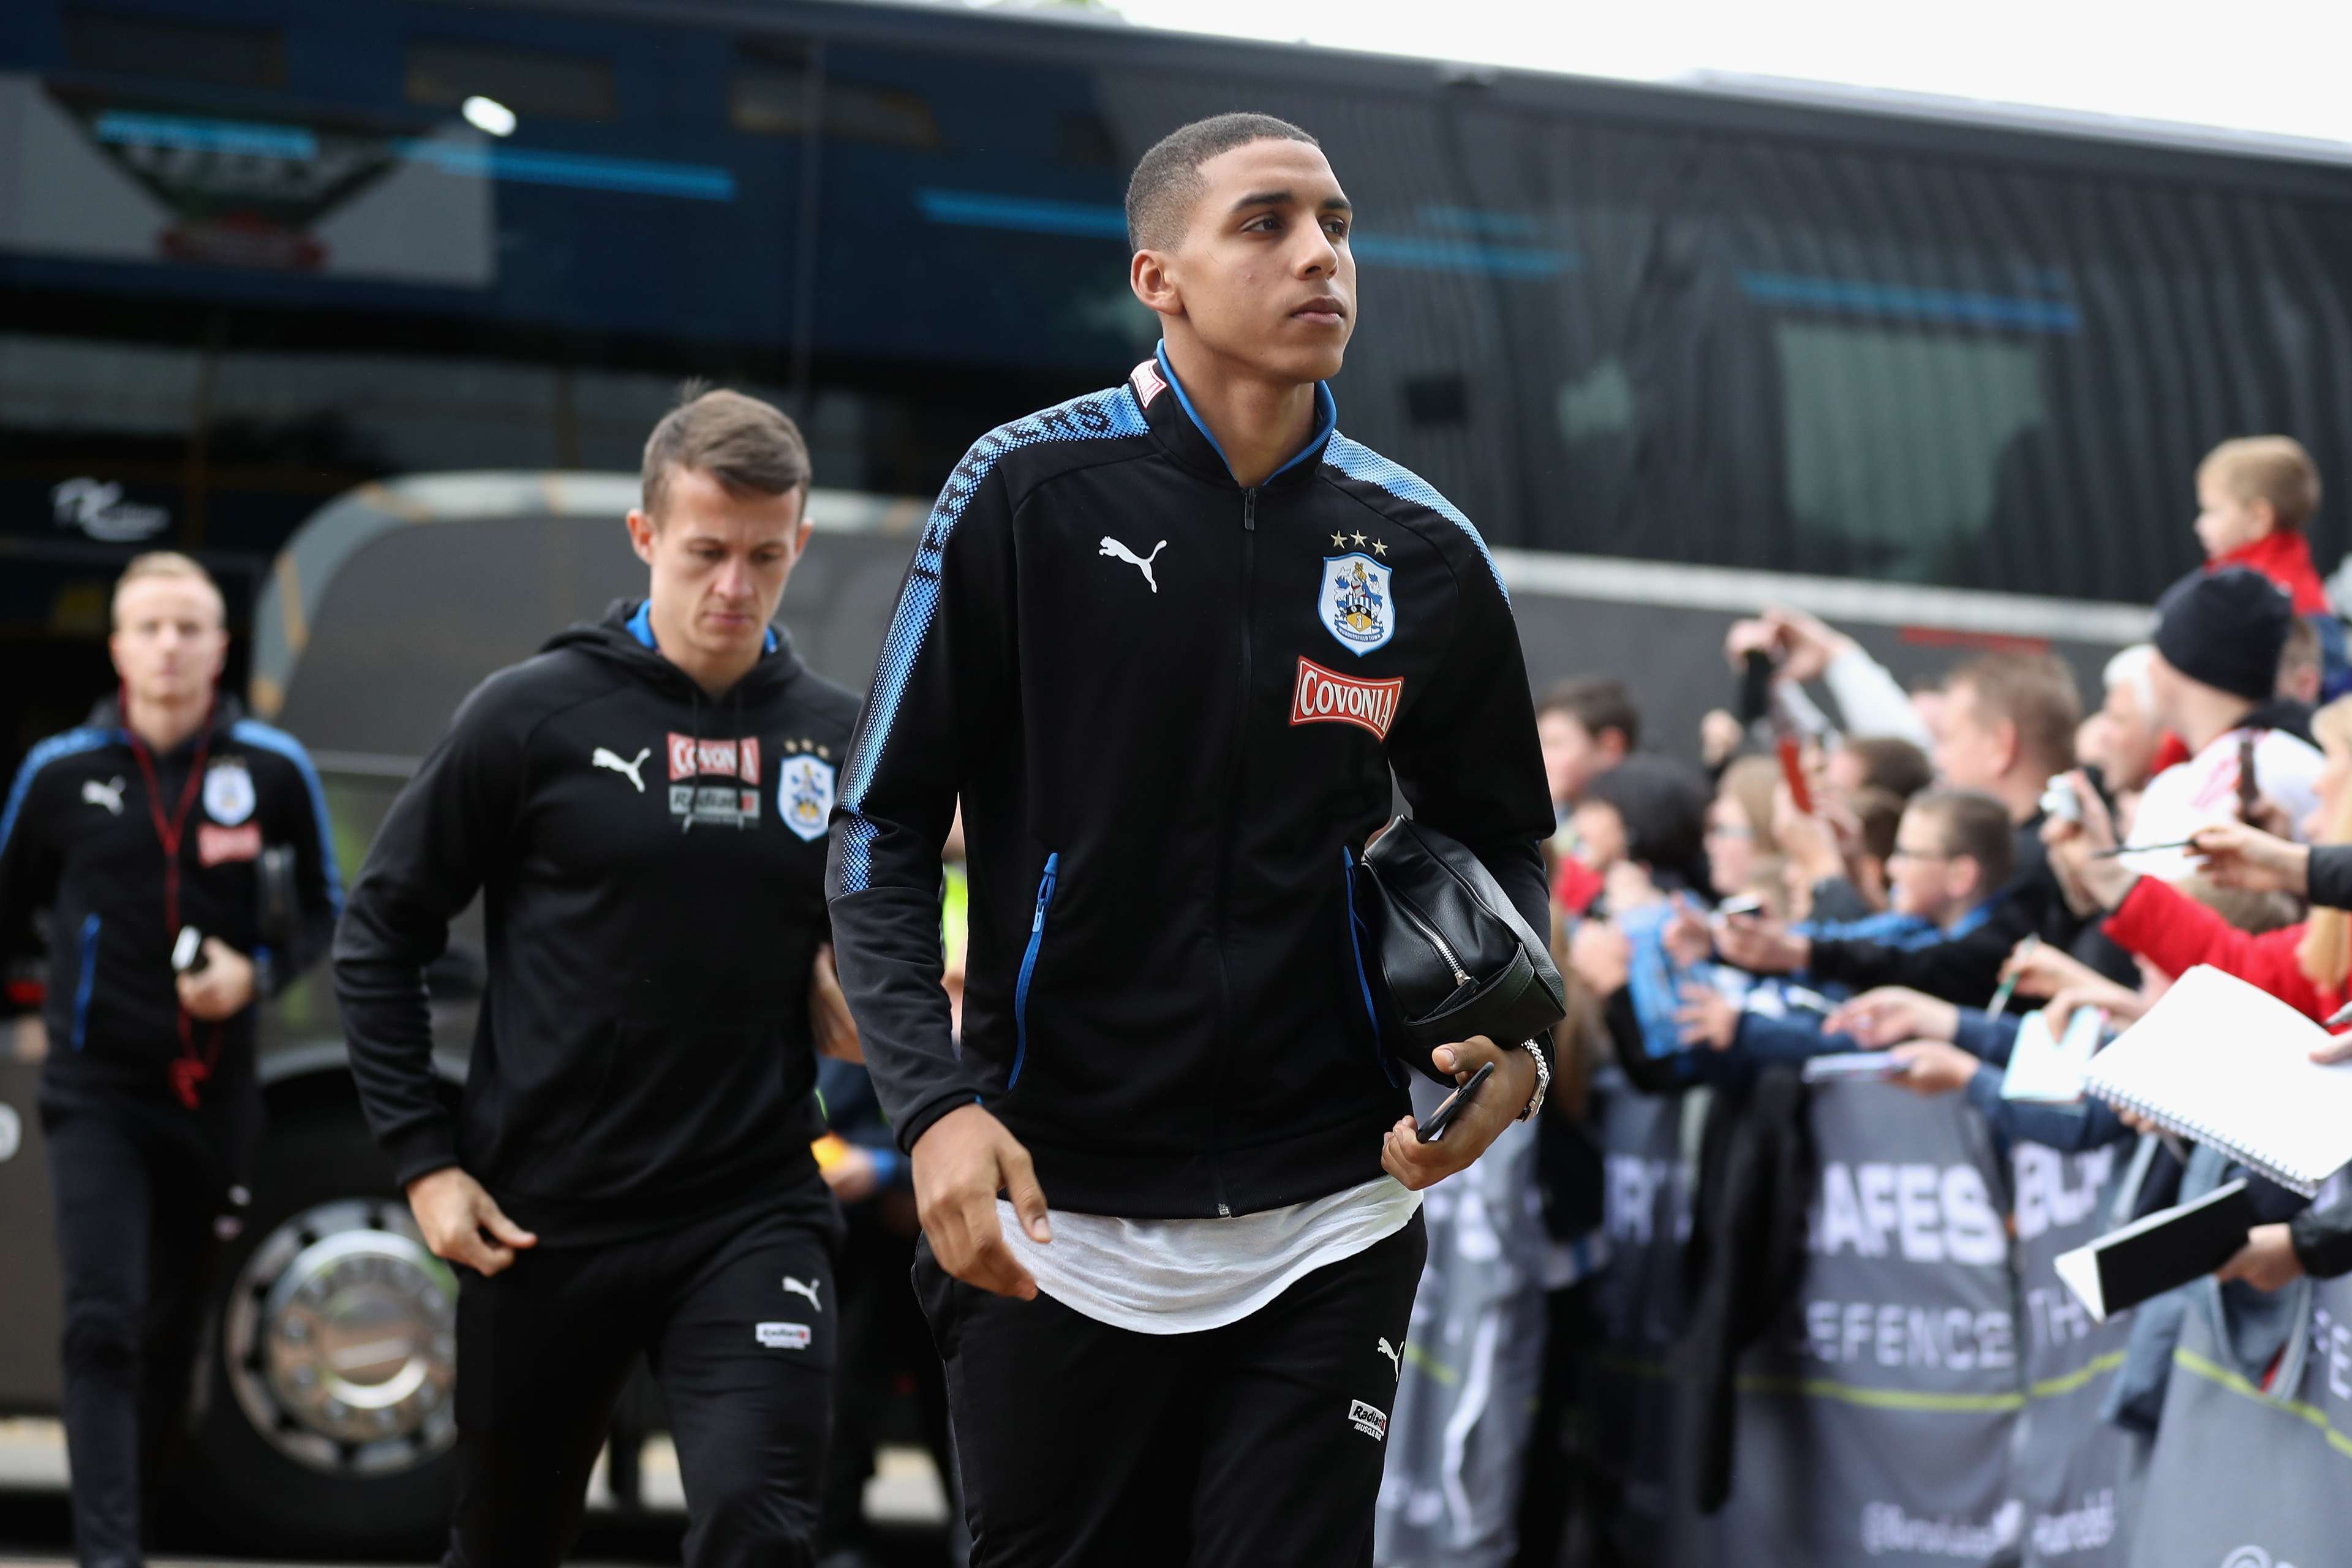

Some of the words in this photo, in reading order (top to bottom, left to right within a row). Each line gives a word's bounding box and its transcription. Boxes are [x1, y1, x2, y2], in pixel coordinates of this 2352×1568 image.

[1300, 669, 1392, 734] COVONIA
[673, 739, 756, 777] COVONA
[1809, 1161, 2008, 1265] AFES
[1806, 1300, 2016, 1371] EFENCE
[1354, 1422, 1375, 1437] MUSCLE
